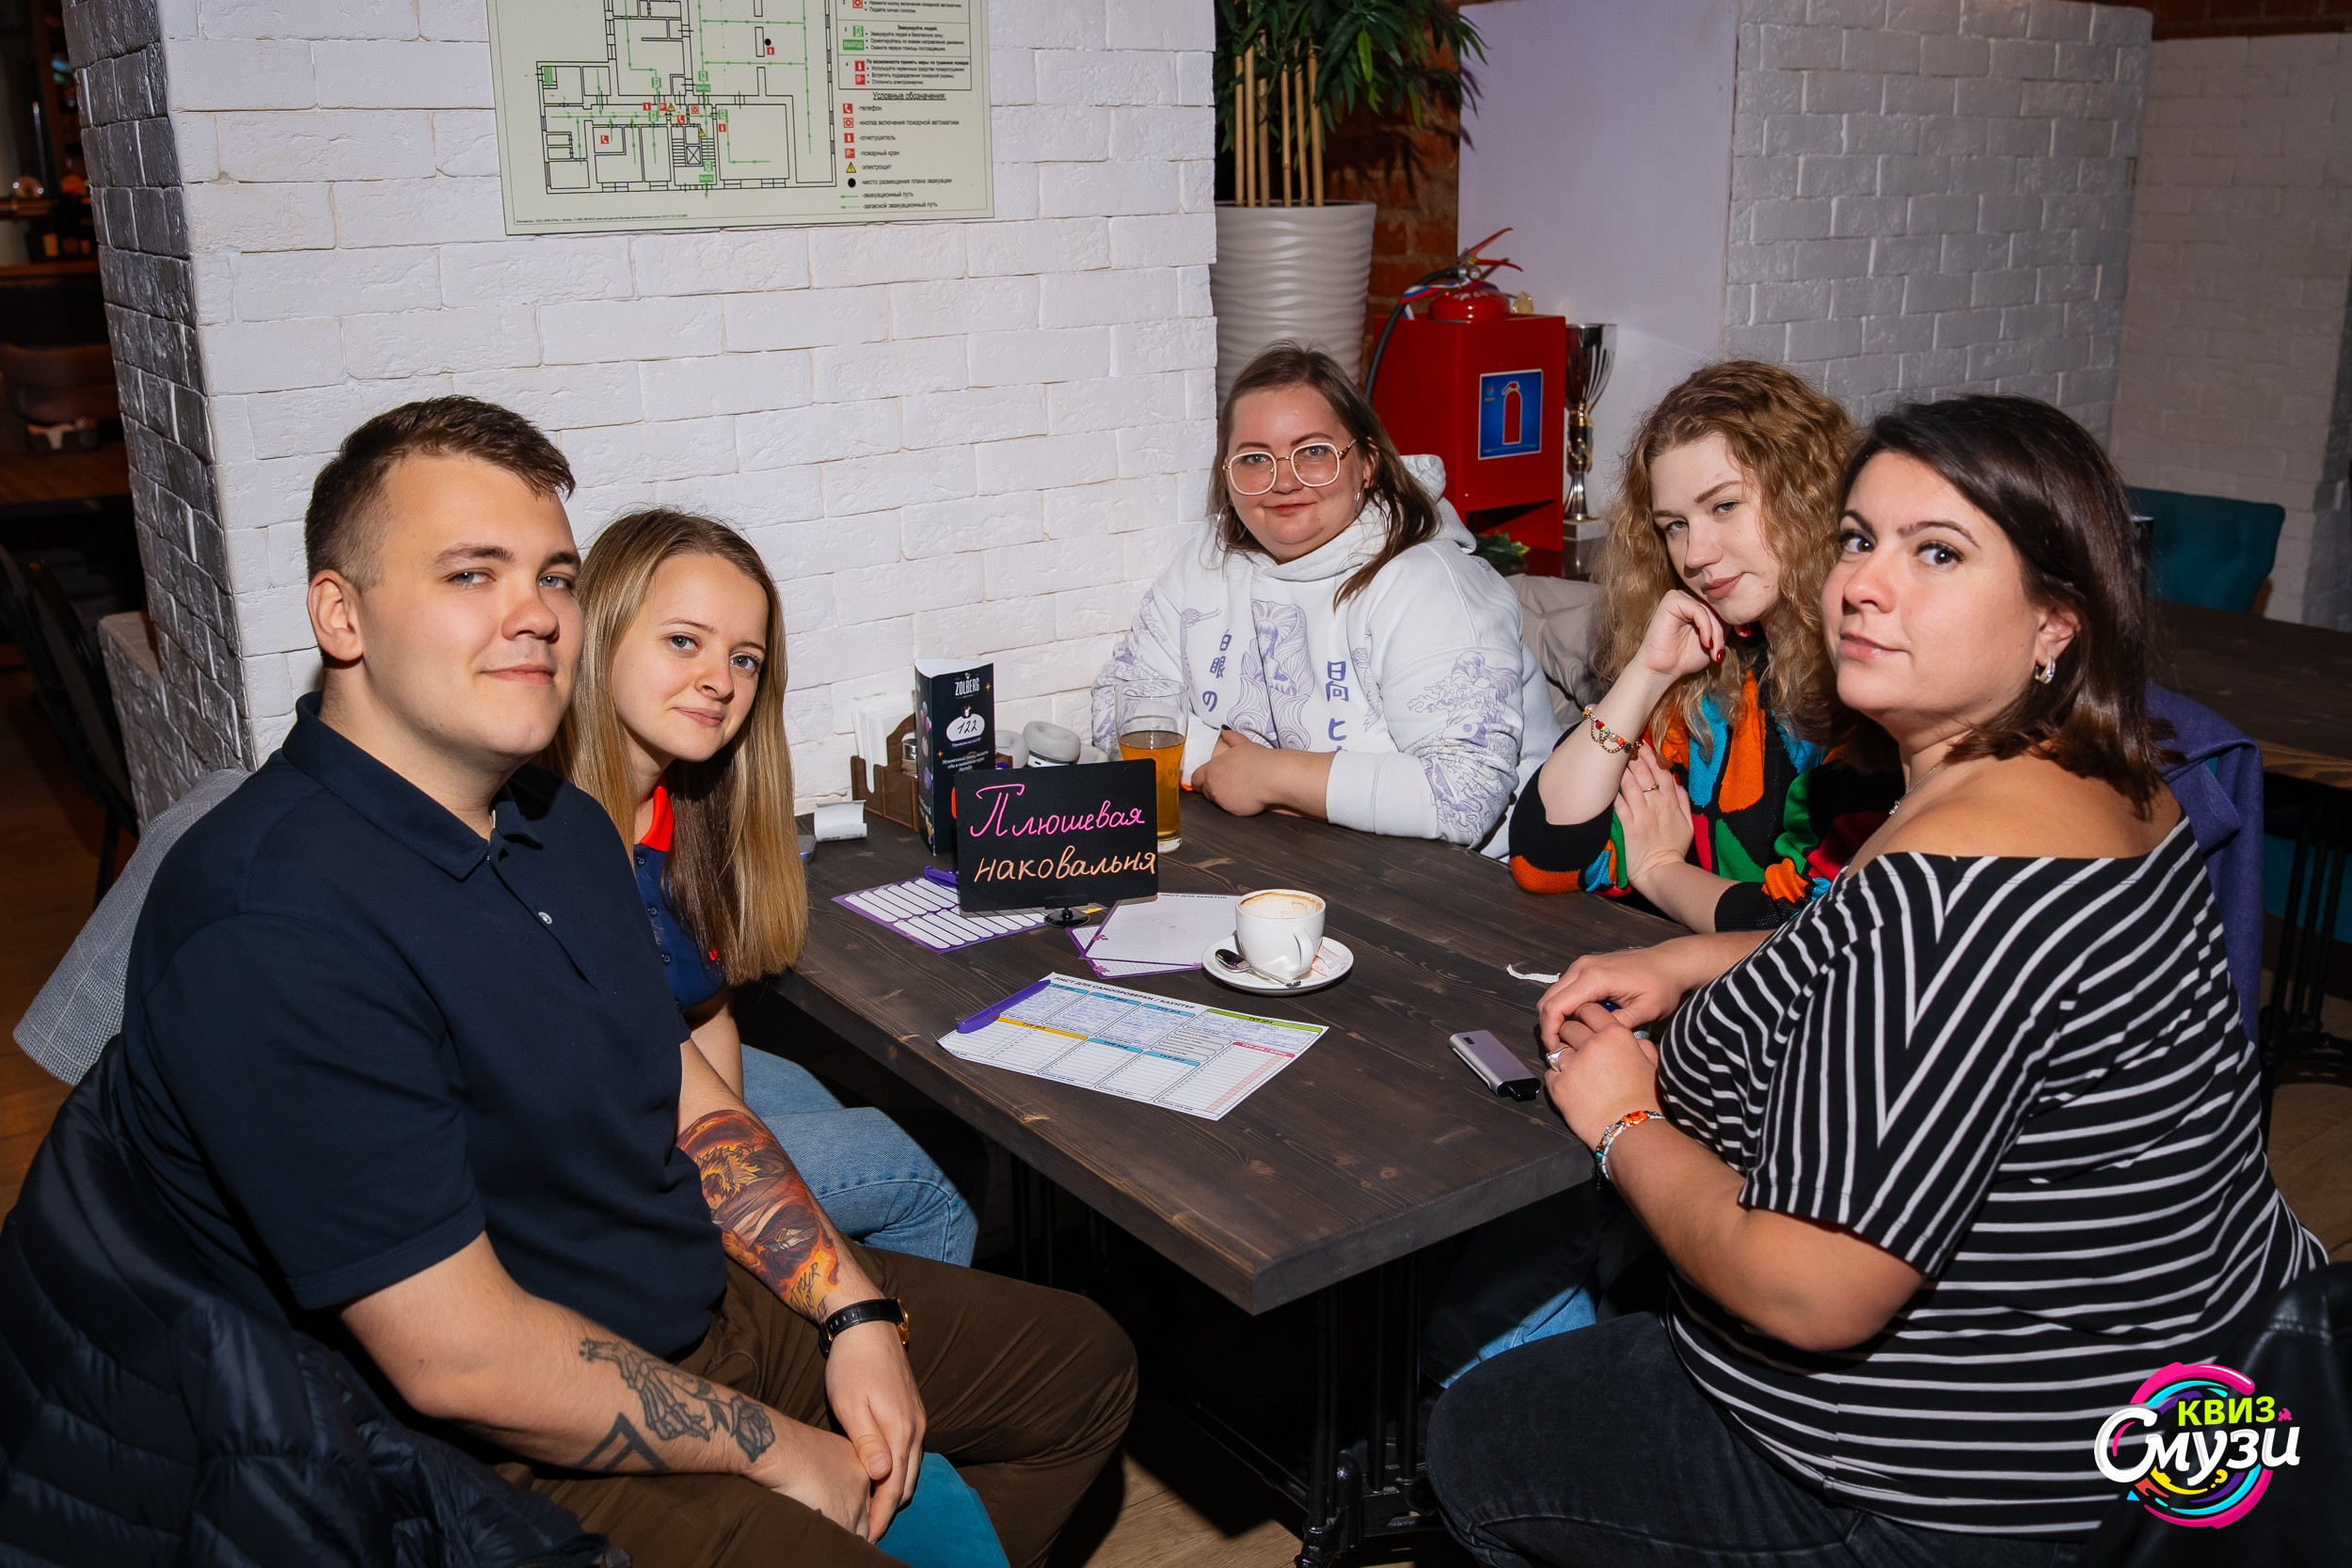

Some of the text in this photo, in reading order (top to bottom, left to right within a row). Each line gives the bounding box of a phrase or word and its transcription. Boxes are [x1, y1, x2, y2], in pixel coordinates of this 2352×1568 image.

[872, 91, 904, 101] Условные
[954, 677, 980, 696] ZOLBERG
[957, 720, 977, 735] 122
[970, 784, 1146, 838] Плюшевая
[974, 845, 1156, 882] наковальня
[1092, 985, 1153, 1001] САМОПРОВЕРКИ
[1159, 999, 1196, 1009] КАУНТЕР
[797, 1261, 821, 1298] YOUR
